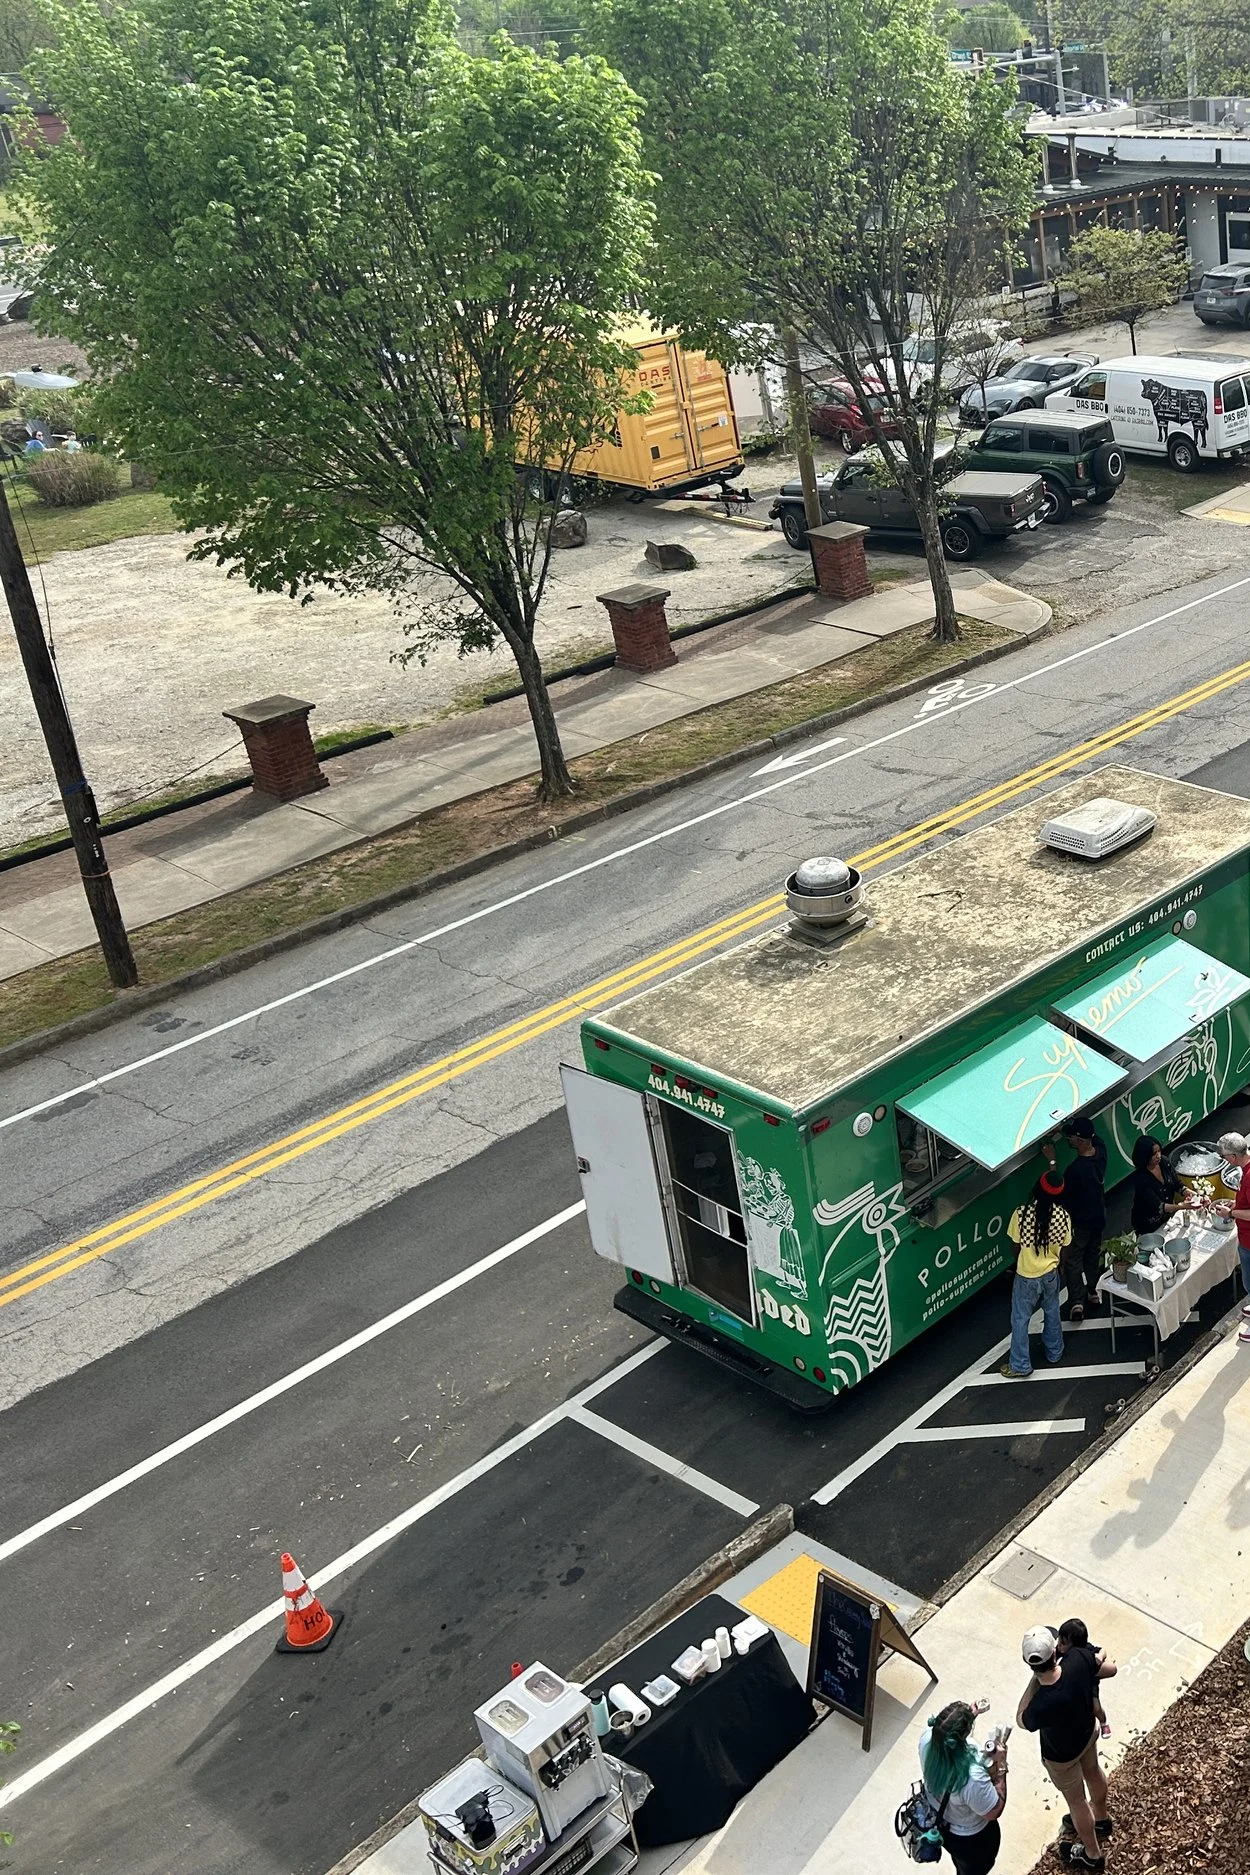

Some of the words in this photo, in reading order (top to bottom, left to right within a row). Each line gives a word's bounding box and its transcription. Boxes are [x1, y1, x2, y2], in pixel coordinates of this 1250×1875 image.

[639, 366, 670, 382] DAS
[1076, 399, 1090, 410] DAS
[1090, 400, 1105, 412] BBQ
[1223, 411, 1236, 424] DAS
[1085, 930, 1125, 963] CONTACT
[1128, 921, 1145, 937] US:
[1148, 884, 1204, 925] 404.941.4747
[648, 1073, 726, 1119] 404.941.4747
[917, 1215, 1003, 1288] POLLO
